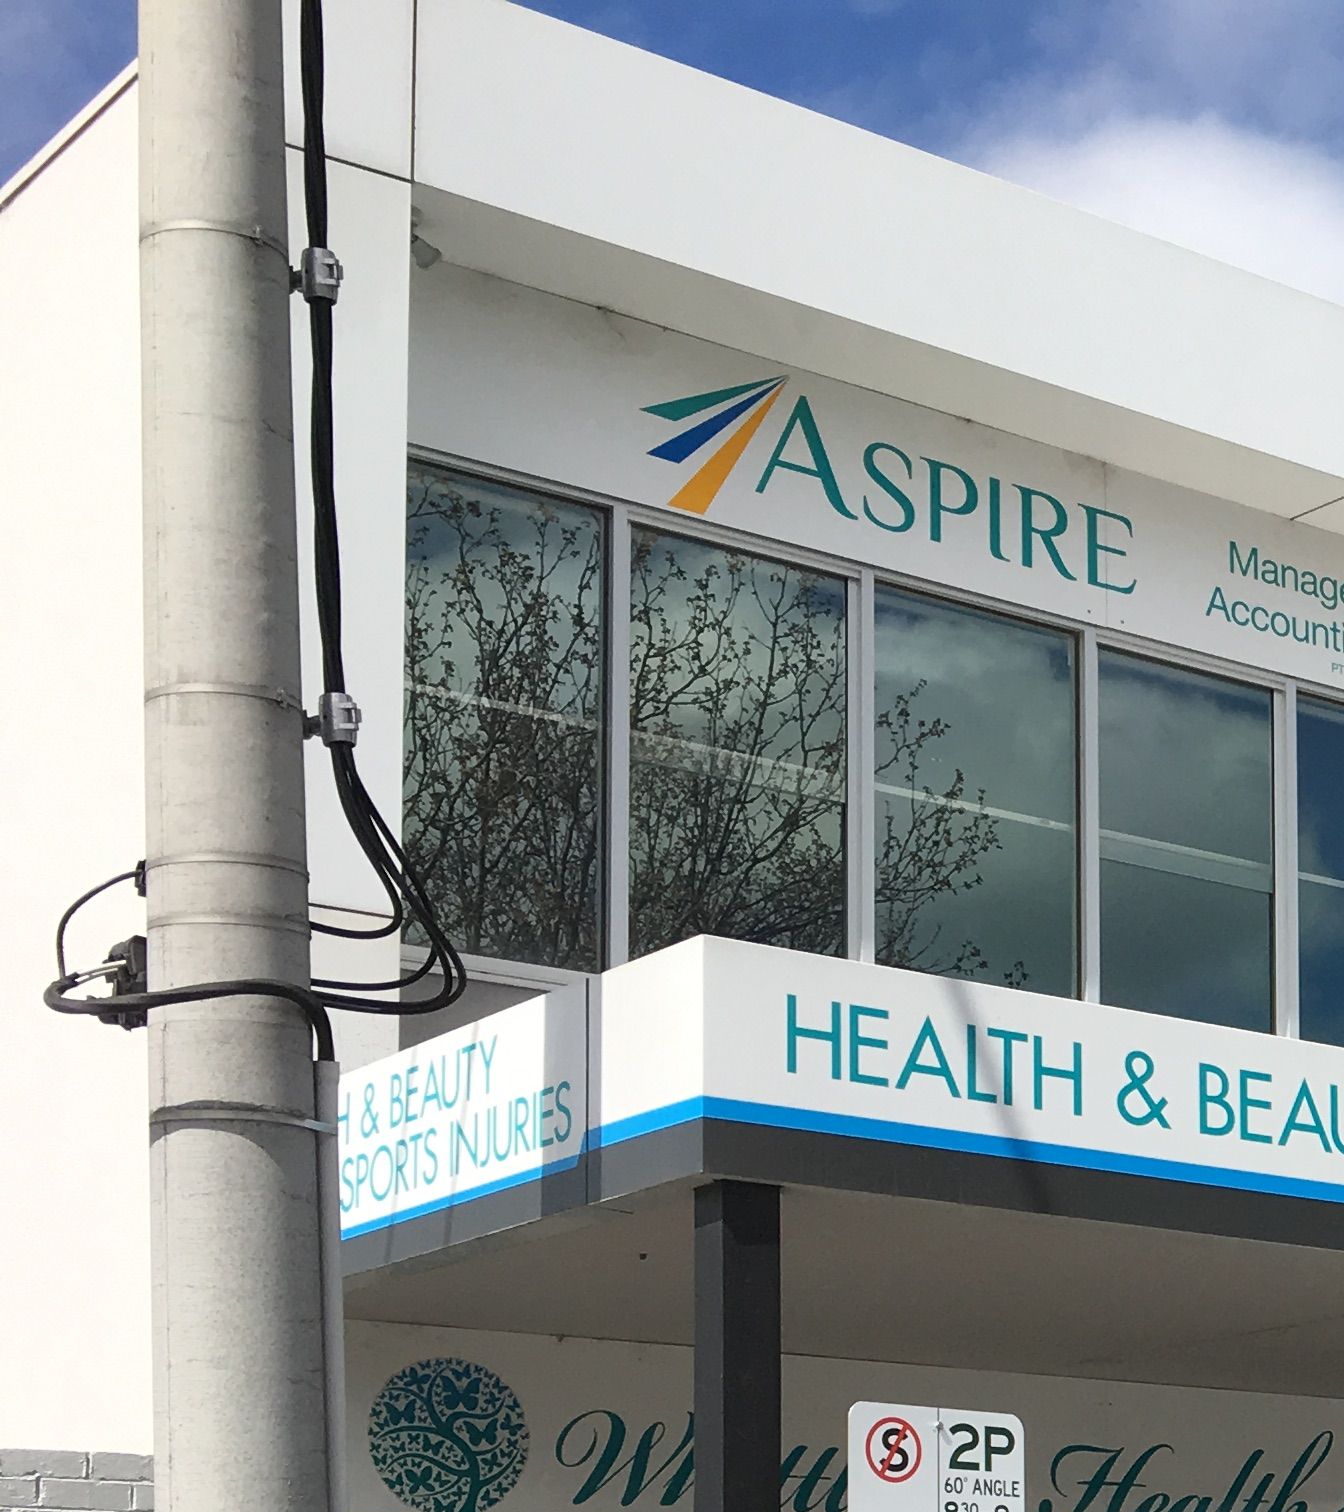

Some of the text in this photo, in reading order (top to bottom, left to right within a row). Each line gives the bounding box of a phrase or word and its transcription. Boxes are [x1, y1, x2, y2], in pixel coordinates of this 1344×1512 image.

[755, 395, 1138, 595] ASPIRE
[361, 1083, 379, 1138] &
[390, 1035, 498, 1129] BEAUTY
[786, 994, 1082, 1116] HEALTH
[1117, 1050, 1171, 1130] &
[340, 1128, 438, 1212] SPORTS
[450, 1081, 572, 1177] INJURIES
[949, 1423, 1015, 1471] 2P
[973, 1479, 1020, 1497] ANGLE
